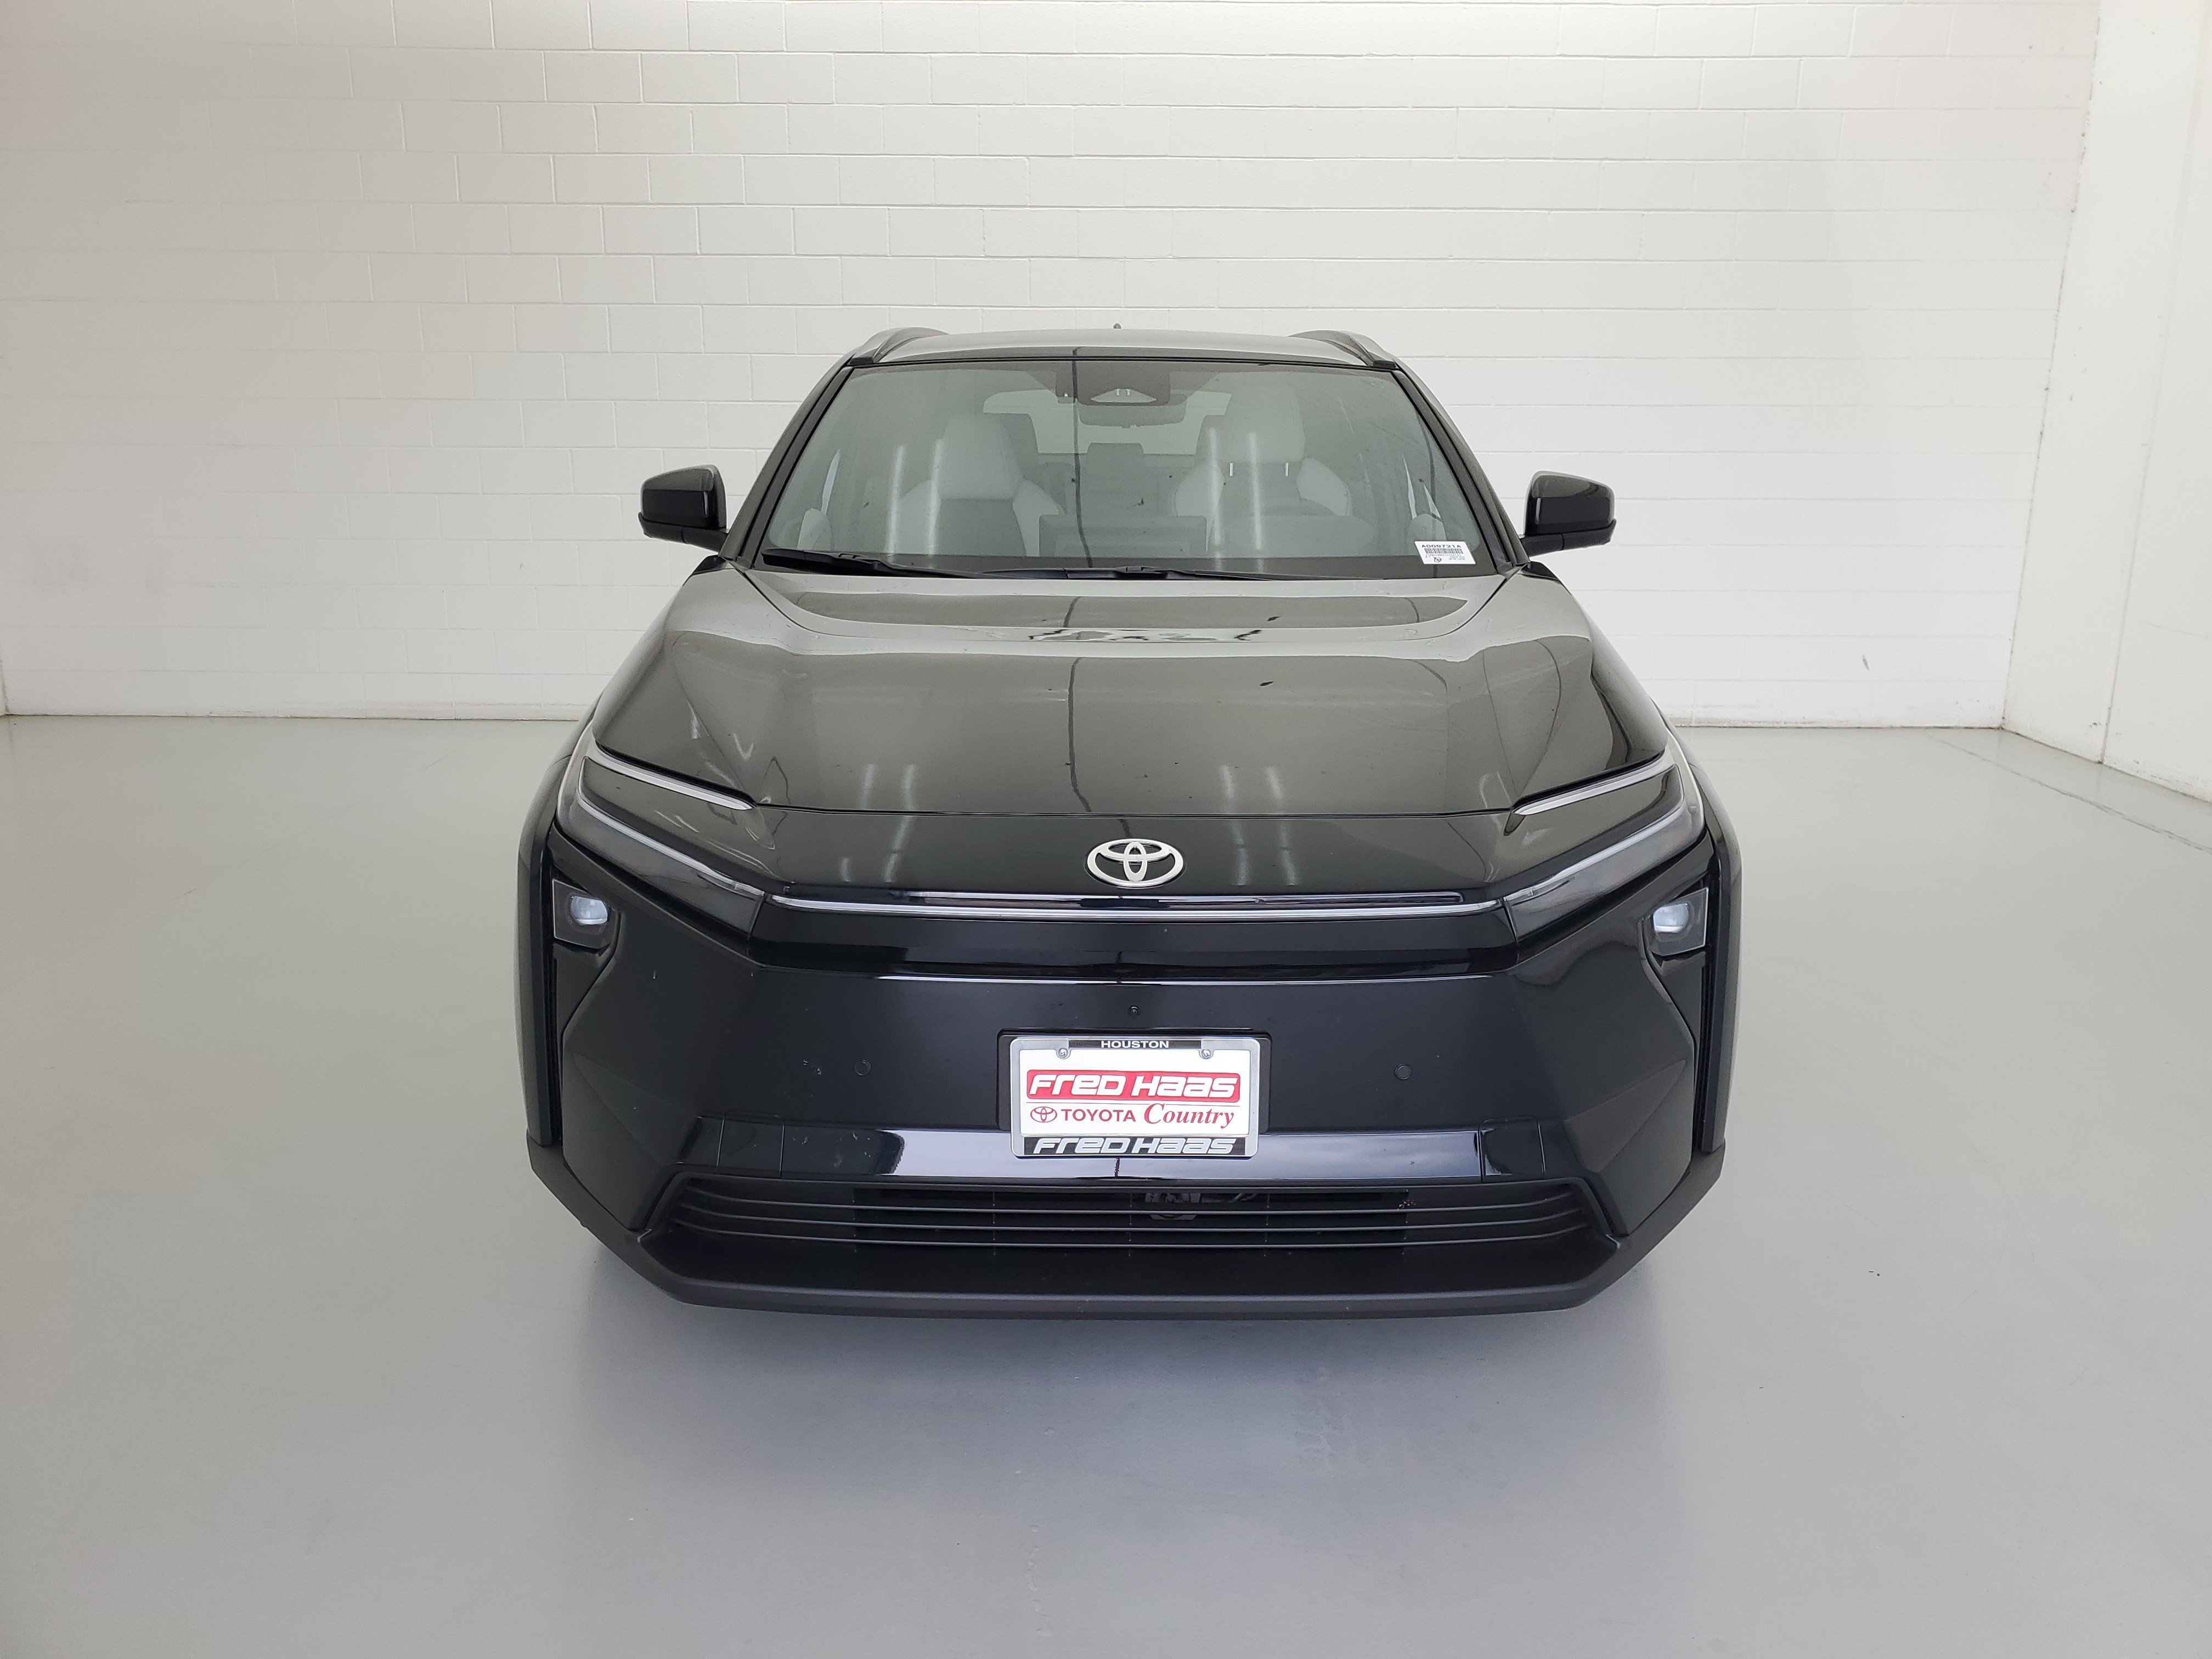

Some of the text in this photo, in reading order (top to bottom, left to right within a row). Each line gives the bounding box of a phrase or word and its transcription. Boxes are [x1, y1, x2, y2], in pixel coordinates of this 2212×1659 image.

[1101, 1040, 1169, 1049] HOUSTON
[1061, 1103, 1234, 1128] TOYOTA Country
